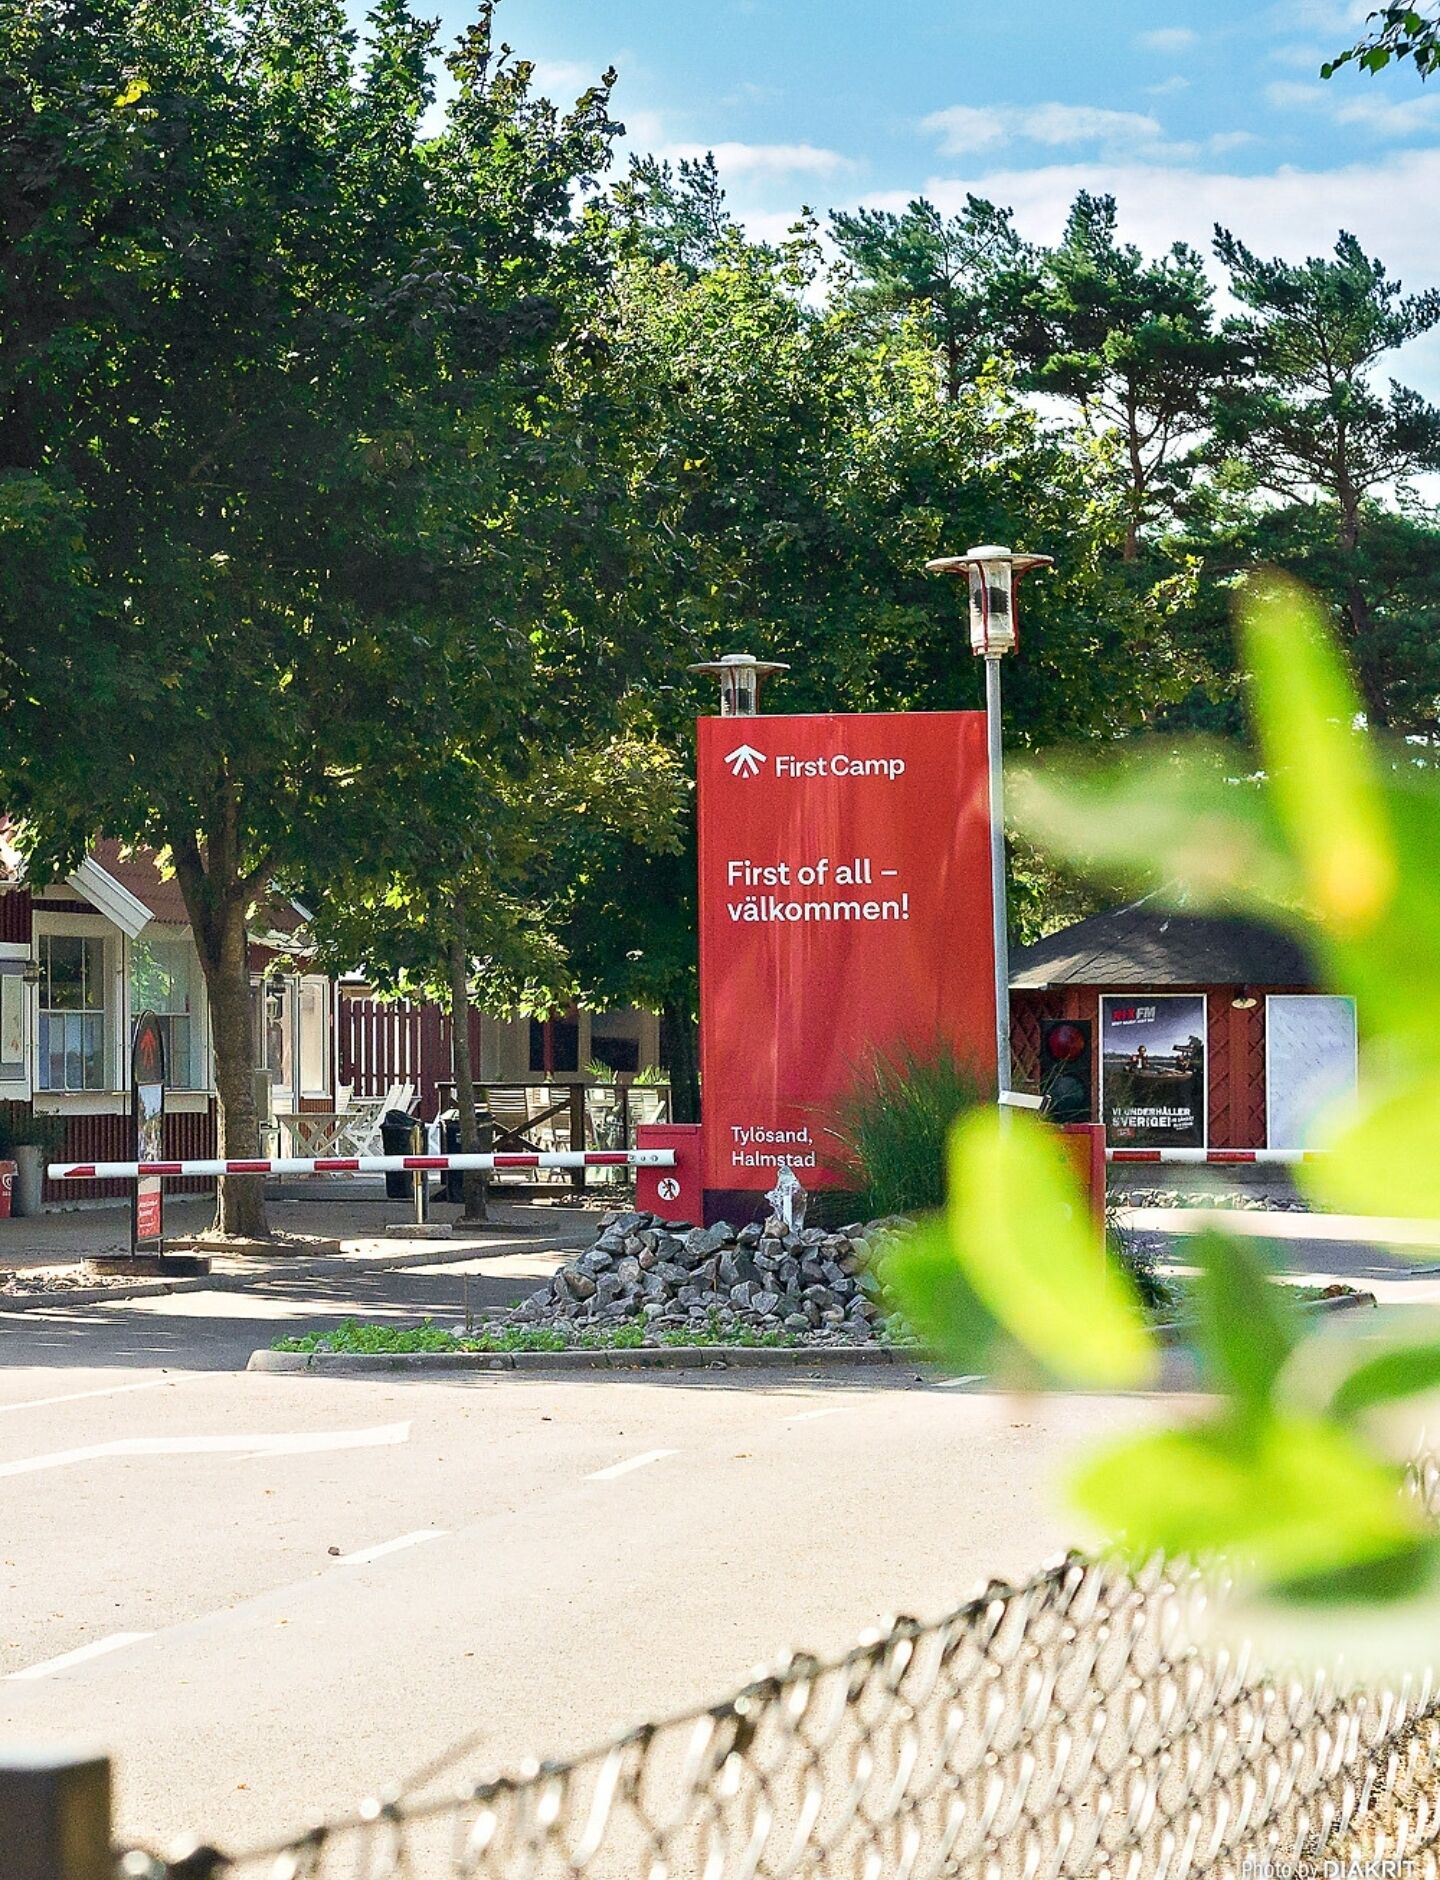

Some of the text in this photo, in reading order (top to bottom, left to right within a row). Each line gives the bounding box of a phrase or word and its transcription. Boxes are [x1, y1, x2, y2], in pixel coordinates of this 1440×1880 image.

[775, 754, 906, 781] First Camp
[727, 860, 790, 886] First
[797, 858, 829, 885] of
[835, 858, 872, 885] all
[726, 893, 910, 922] välkommen!
[730, 1125, 813, 1146] Tylösand,
[731, 1150, 816, 1168] Halmstad
